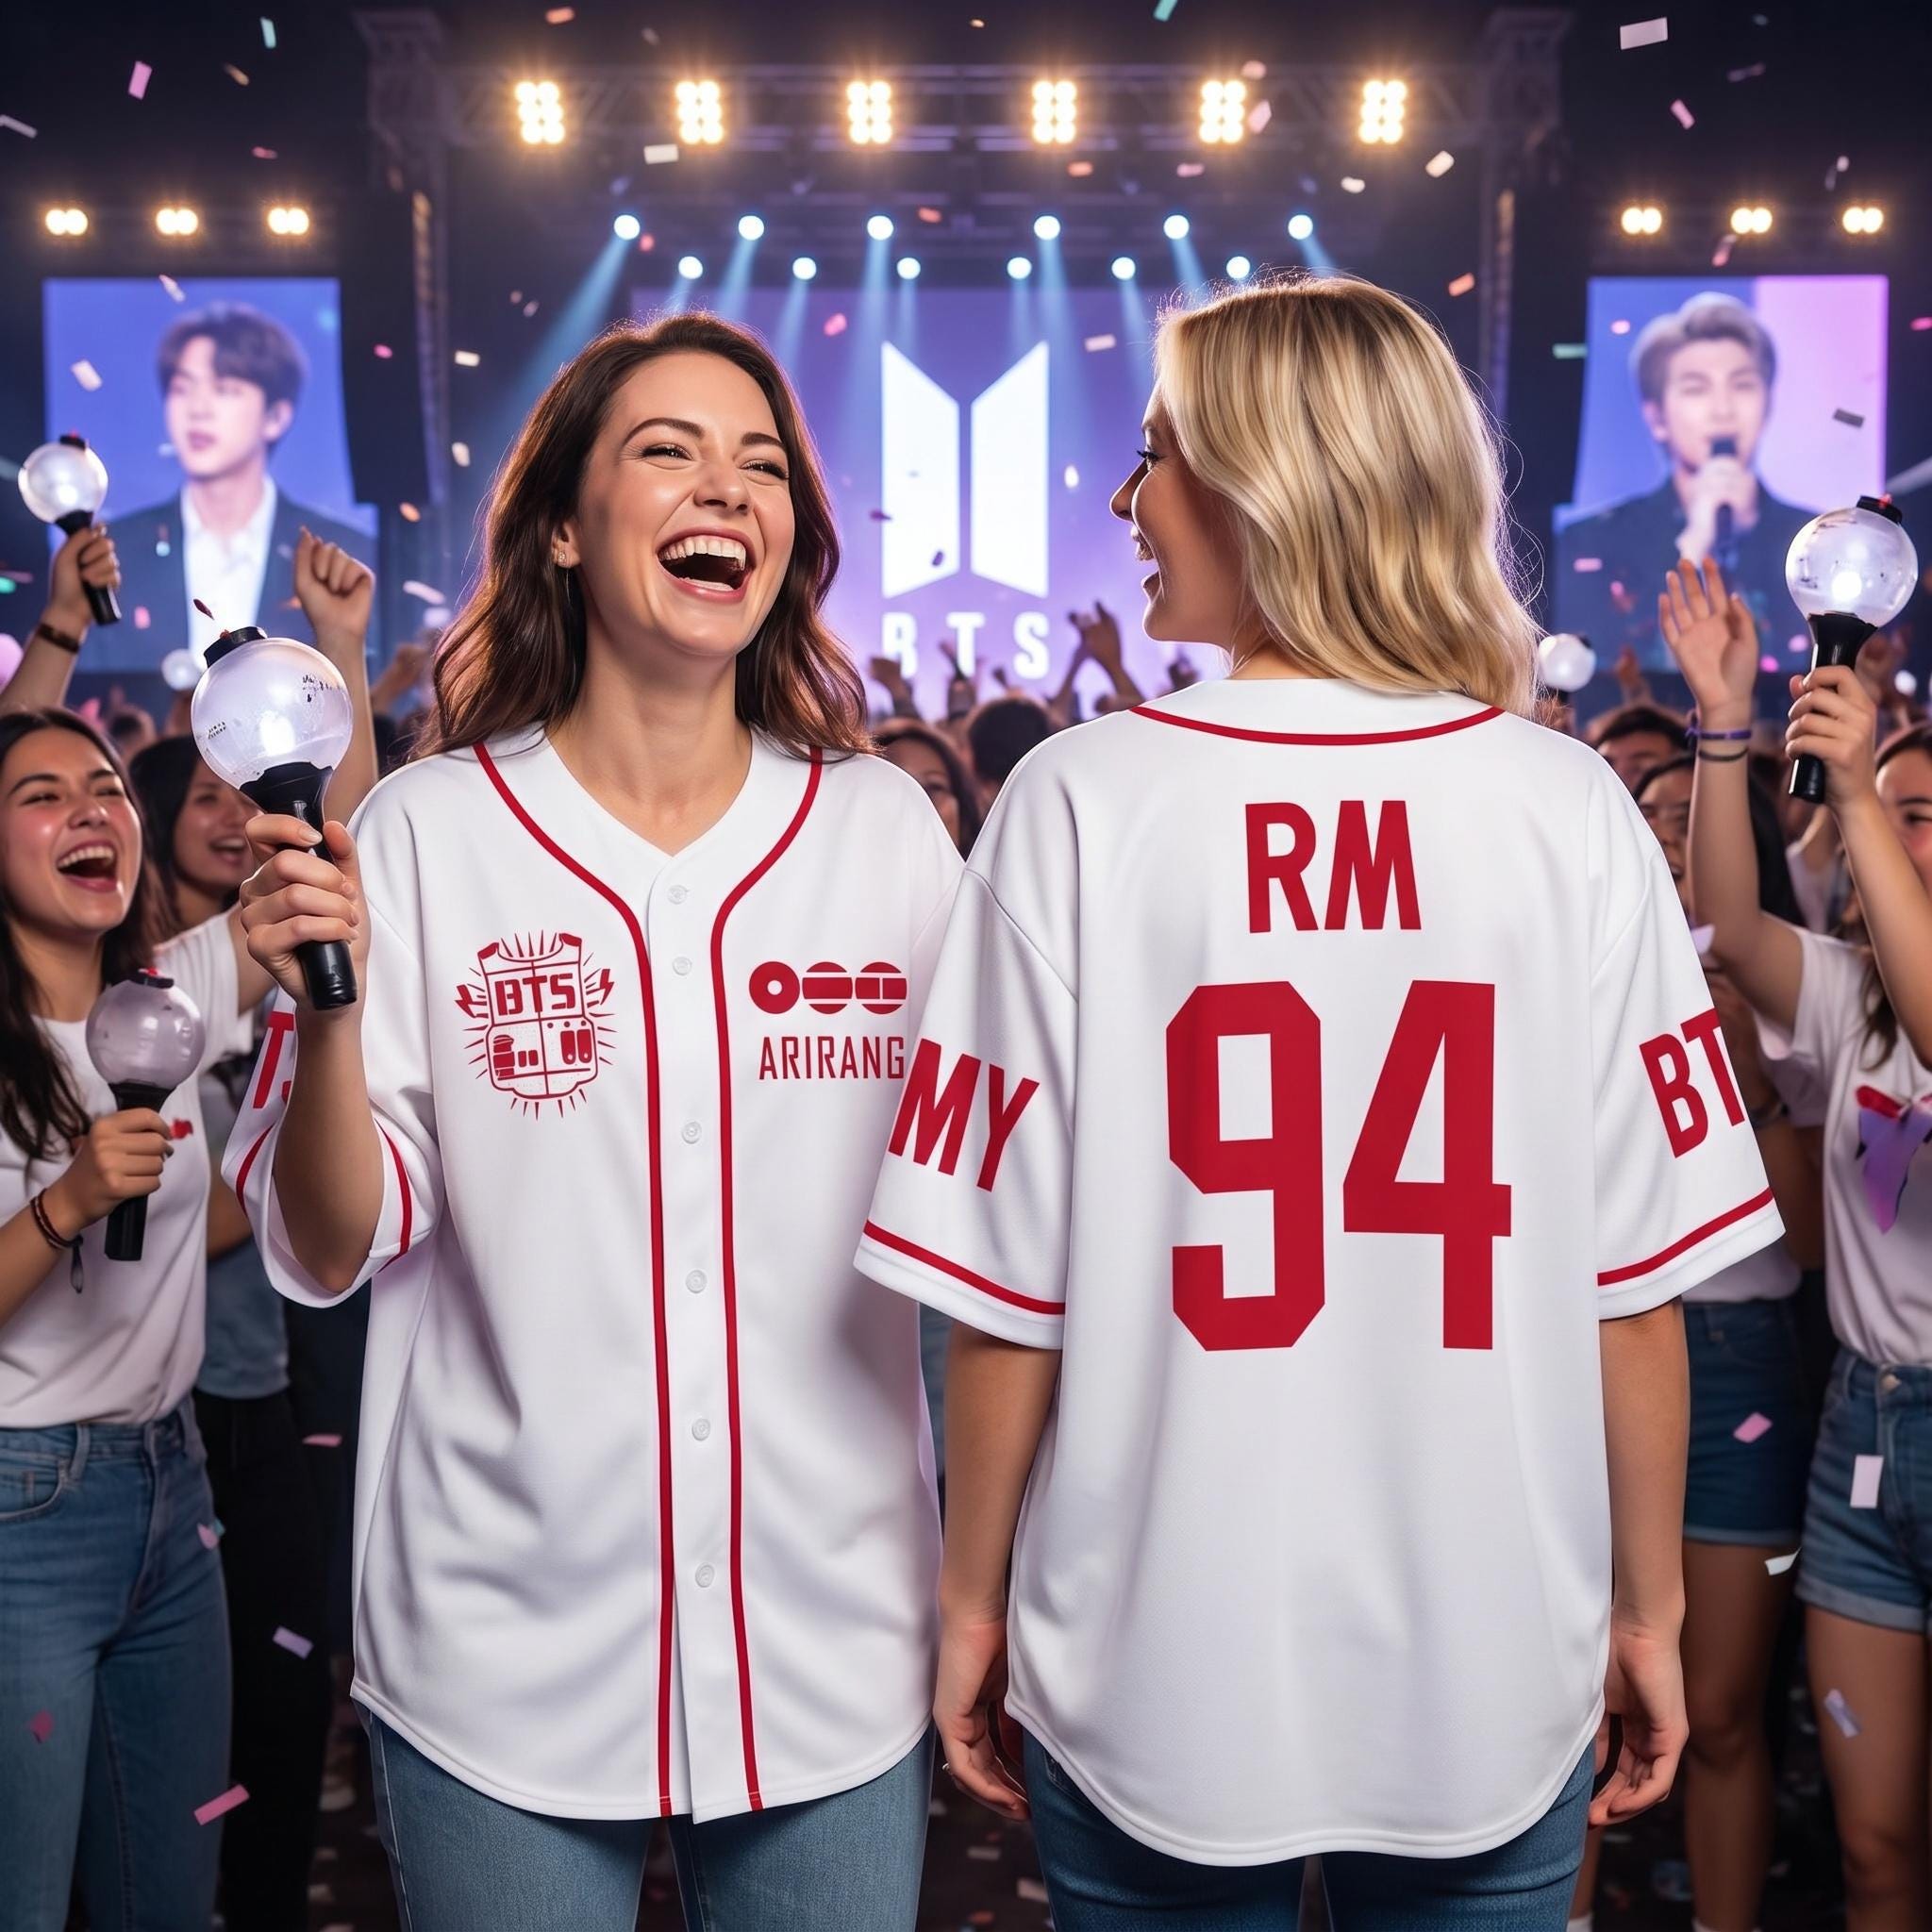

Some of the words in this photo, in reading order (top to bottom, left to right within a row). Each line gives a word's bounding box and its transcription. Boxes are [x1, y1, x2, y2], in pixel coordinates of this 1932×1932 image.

[882, 611, 1050, 679] BTS
[1245, 800, 1422, 933] RM
[494, 973, 576, 1016] BTS
[758, 1036, 905, 1080] ARIRANG
[888, 1038, 1041, 1193] MY
[1639, 1008, 1746, 1158] BT
[1166, 979, 1512, 1351] 94
